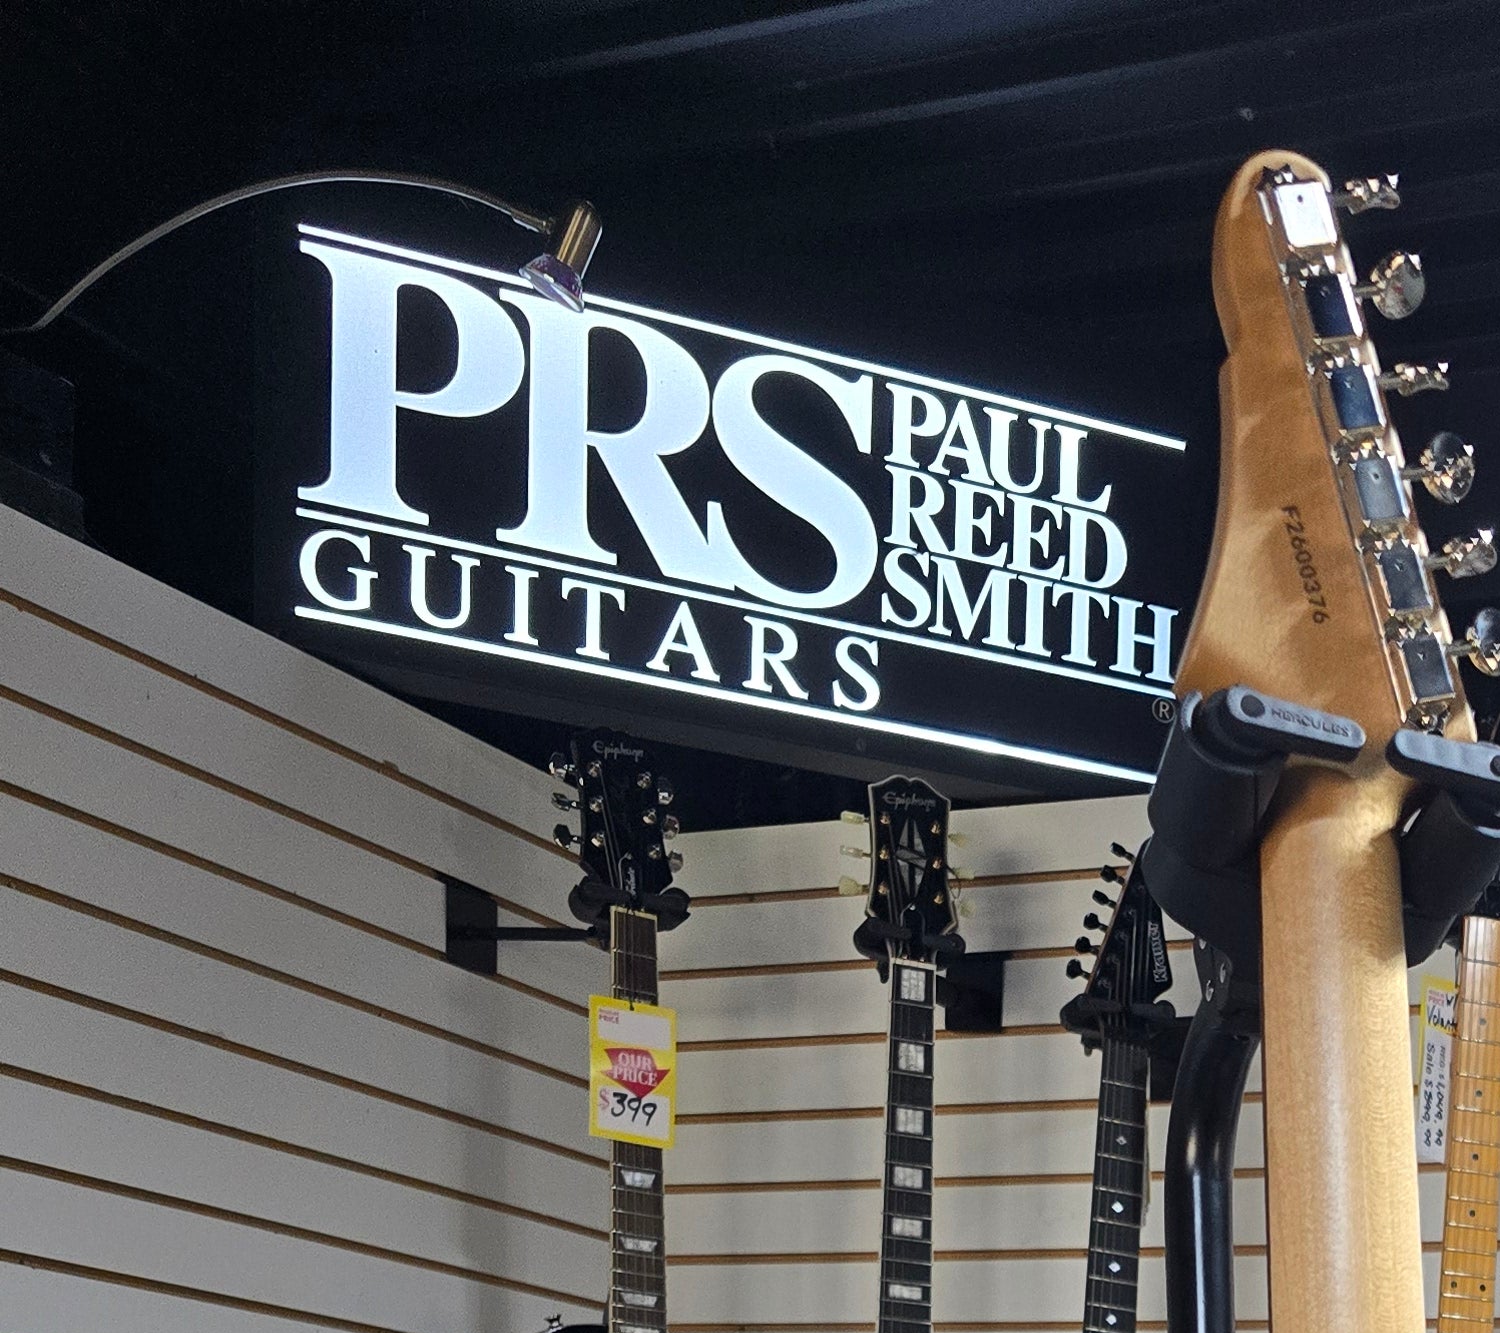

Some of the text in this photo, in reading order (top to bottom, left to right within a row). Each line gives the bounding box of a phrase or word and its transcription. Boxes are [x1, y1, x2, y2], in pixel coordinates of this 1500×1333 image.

[297, 240, 878, 610] PRS
[884, 381, 1114, 513] PAUL
[884, 463, 1129, 590] REED
[297, 528, 882, 713] GUITARS
[881, 546, 1180, 684] SMITH
[1271, 706, 1350, 738] HERCULES
[598, 1088, 658, 1127] $399
[612, 1067, 658, 1087] PRICE
[618, 1052, 652, 1072] OUR
